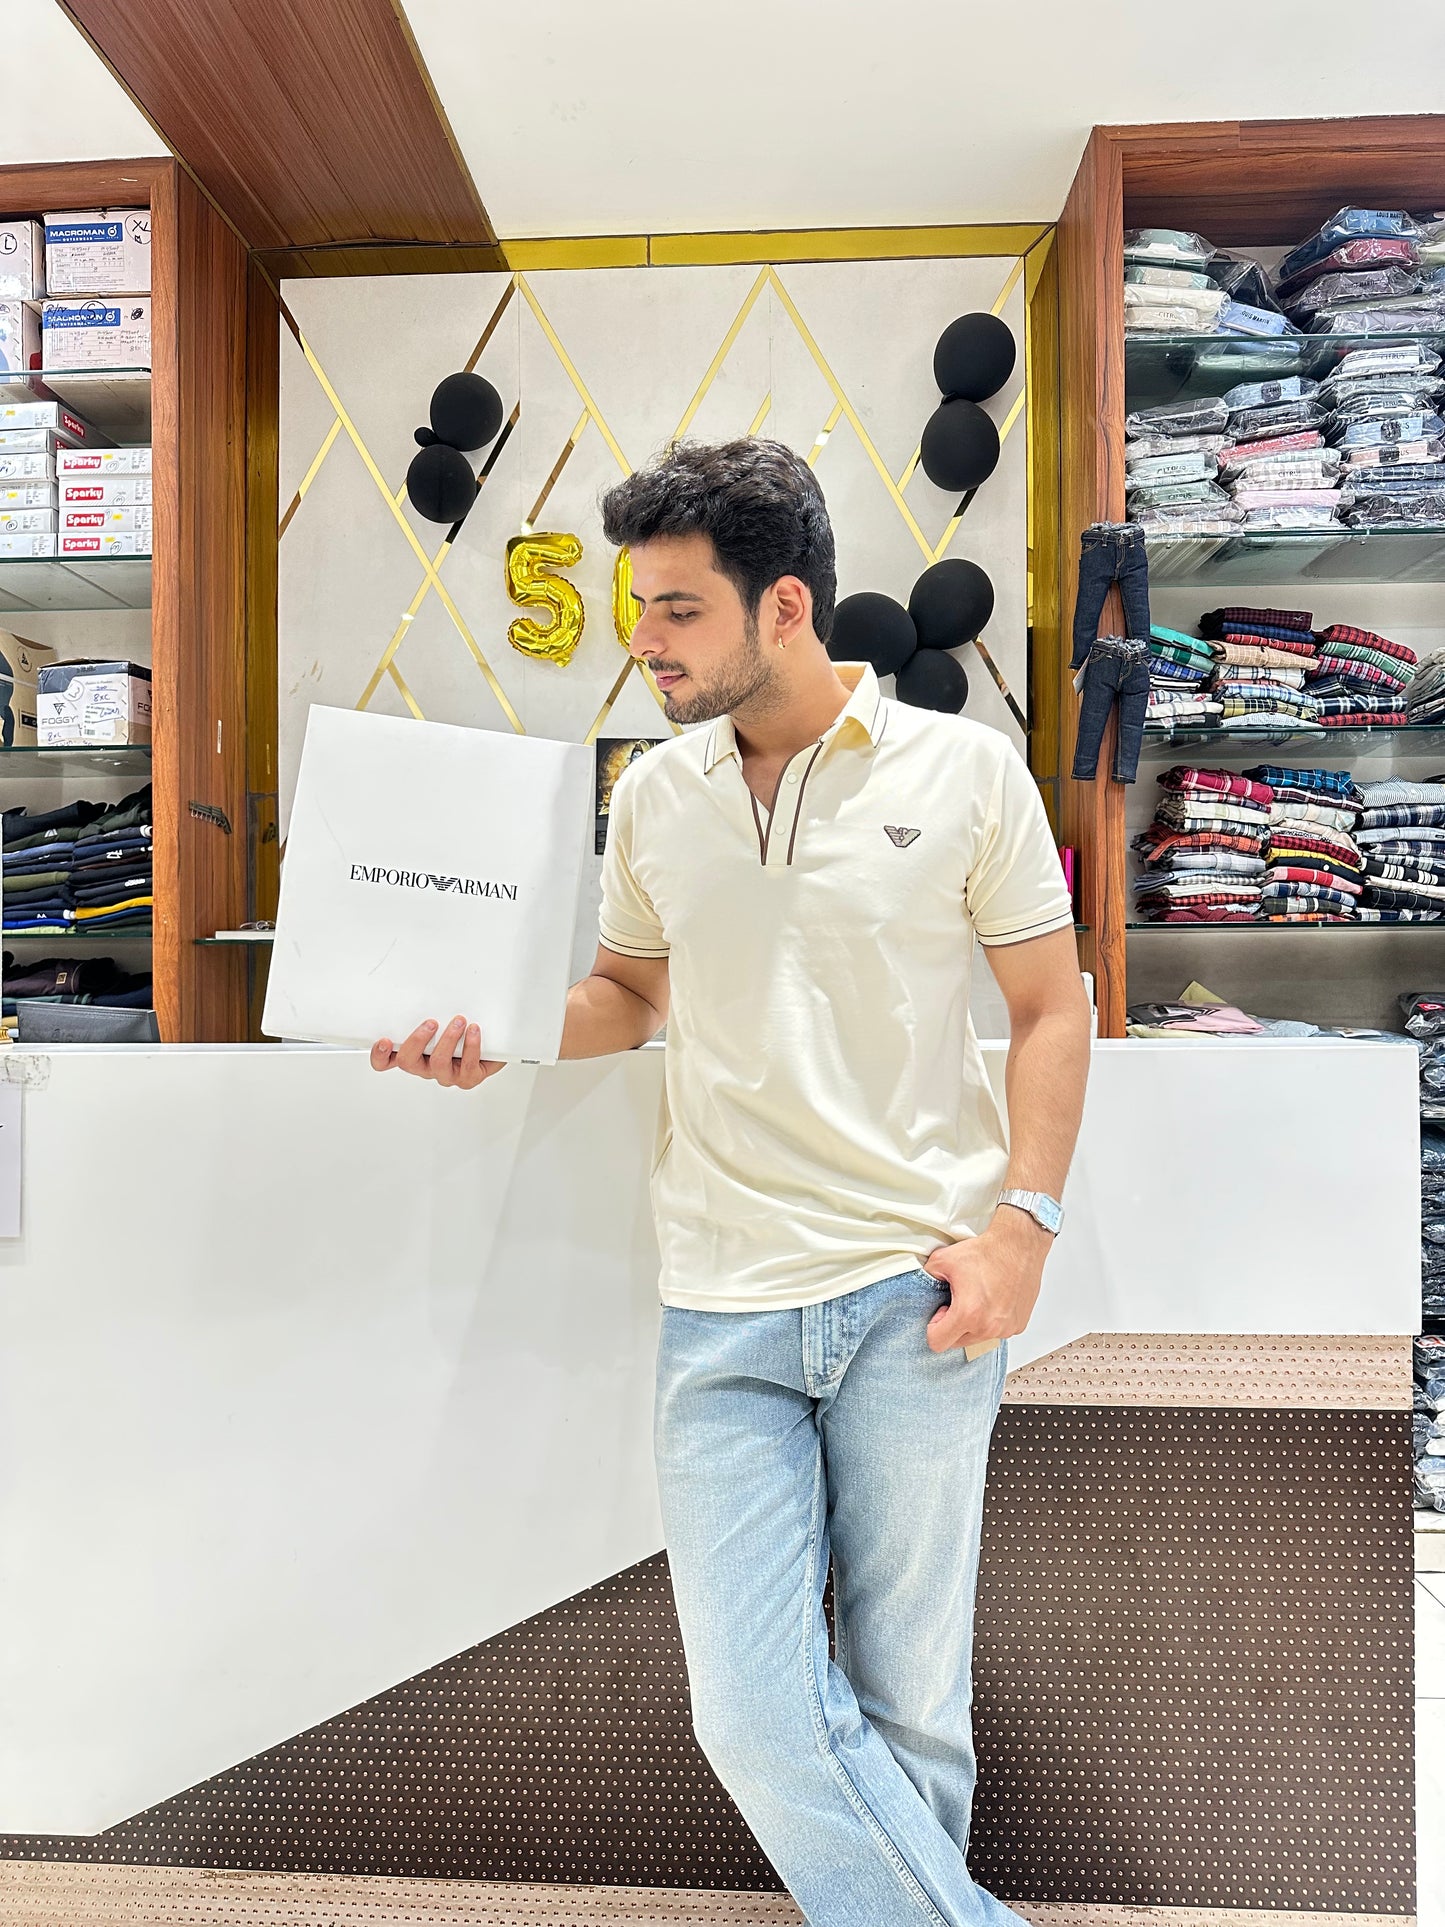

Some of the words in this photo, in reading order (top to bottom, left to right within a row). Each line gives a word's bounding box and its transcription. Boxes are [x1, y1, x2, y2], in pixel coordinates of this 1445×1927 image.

[50, 229, 105, 237] MACROMAN
[64, 456, 101, 468] Sparky
[66, 488, 103, 500] Sparky
[67, 515, 104, 527] Sparky
[64, 539, 99, 550] Sparky
[41, 716, 76, 725] FOGGY
[350, 864, 429, 889] EMPORIO
[451, 878, 518, 901] ARMANI
